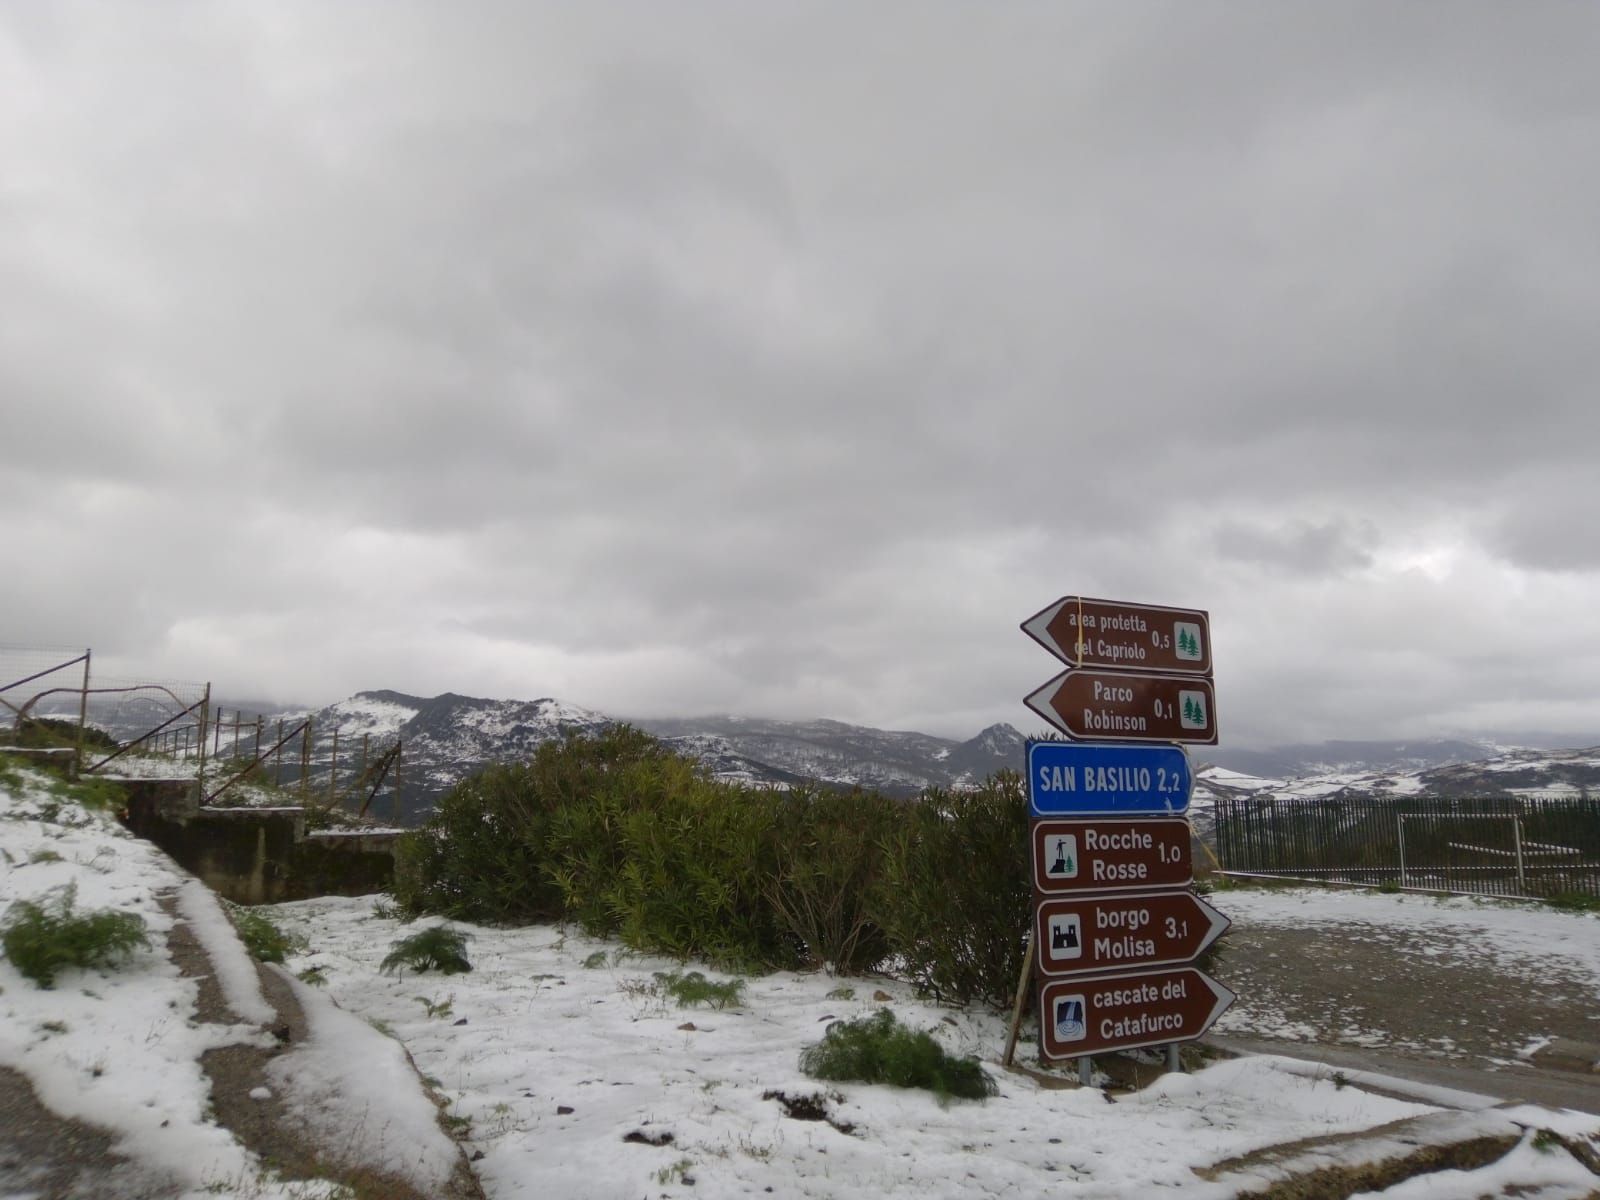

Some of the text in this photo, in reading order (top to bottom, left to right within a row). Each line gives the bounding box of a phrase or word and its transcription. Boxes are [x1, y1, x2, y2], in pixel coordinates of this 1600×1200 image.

[1100, 616, 1147, 632] protetta
[1097, 640, 1146, 661] Capriolo
[1094, 681, 1133, 702] Parco
[1084, 708, 1147, 731] Robinson
[1040, 766, 1076, 792] SAN
[1084, 766, 1150, 792] BASILIO
[1085, 828, 1153, 850] Rocche
[1093, 858, 1148, 881] Rosse
[1096, 907, 1150, 930] borgo
[1094, 936, 1155, 960] Molisa
[1093, 979, 1186, 1008] cascate del
[1100, 1013, 1183, 1039] Catafurco
